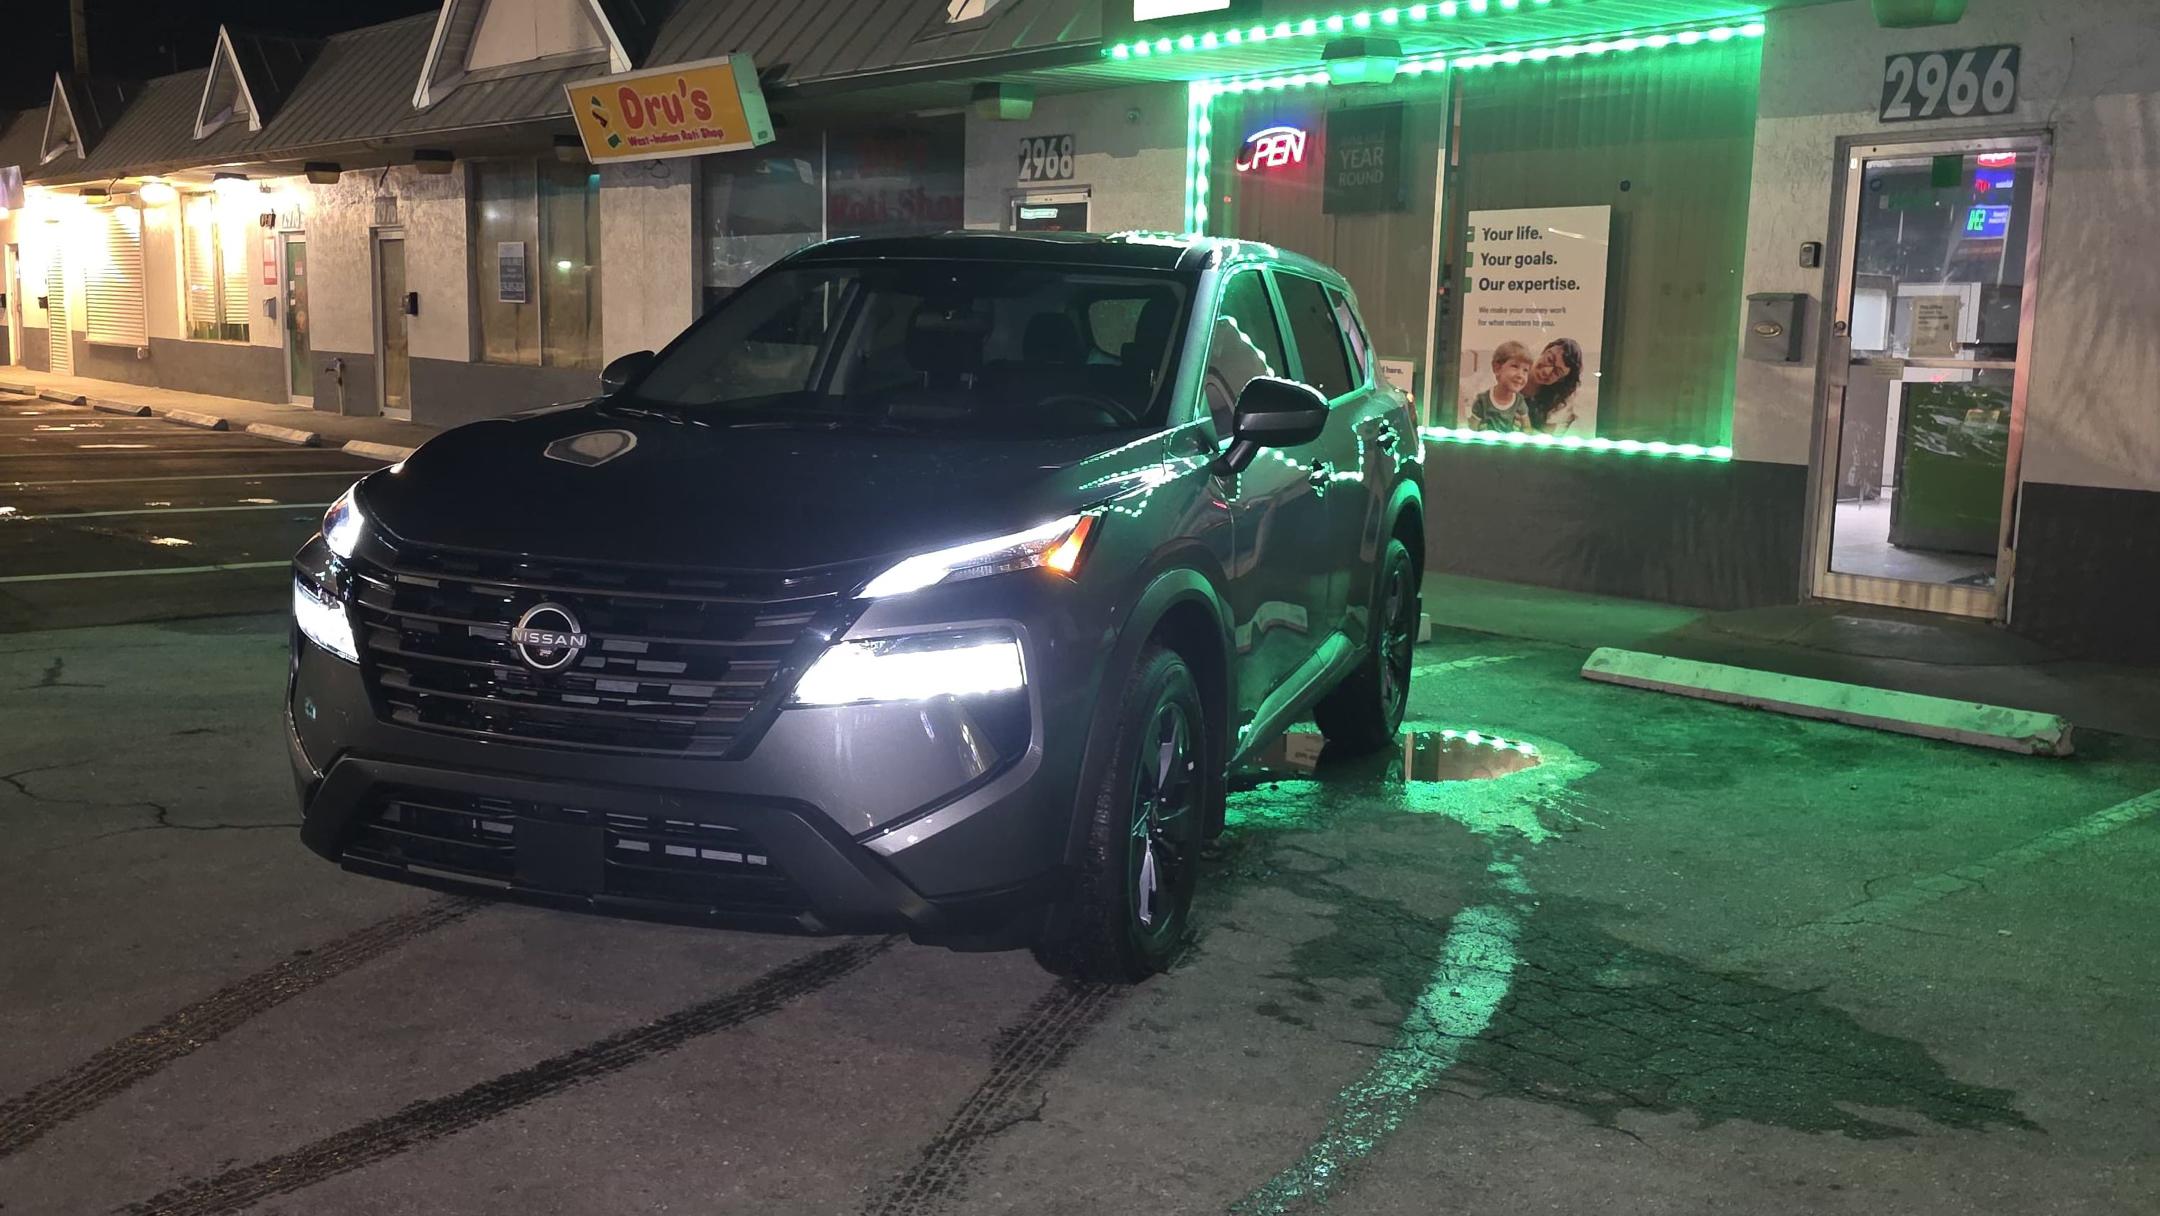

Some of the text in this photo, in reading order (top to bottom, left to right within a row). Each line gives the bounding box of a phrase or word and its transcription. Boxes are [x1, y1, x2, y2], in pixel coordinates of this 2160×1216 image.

[1883, 48, 2015, 119] 2966
[618, 78, 713, 130] Dru's
[701, 128, 724, 139] Shop
[1236, 126, 1306, 172] OPEN
[1340, 146, 1384, 169] YEAR
[1018, 136, 1073, 181] 2968
[1338, 169, 1384, 187] ROUND
[1482, 225, 1543, 241] Your life.
[1481, 251, 1558, 269] Your goals.
[1478, 276, 1580, 293] Our expertise.
[1508, 307, 1524, 316] your
[1524, 306, 1548, 315] money
[1477, 319, 1487, 327] for
[1488, 319, 1504, 327] what
[1505, 319, 1531, 327] matters
[1532, 319, 1540, 327] to
[512, 629, 584, 647] NISSAN
